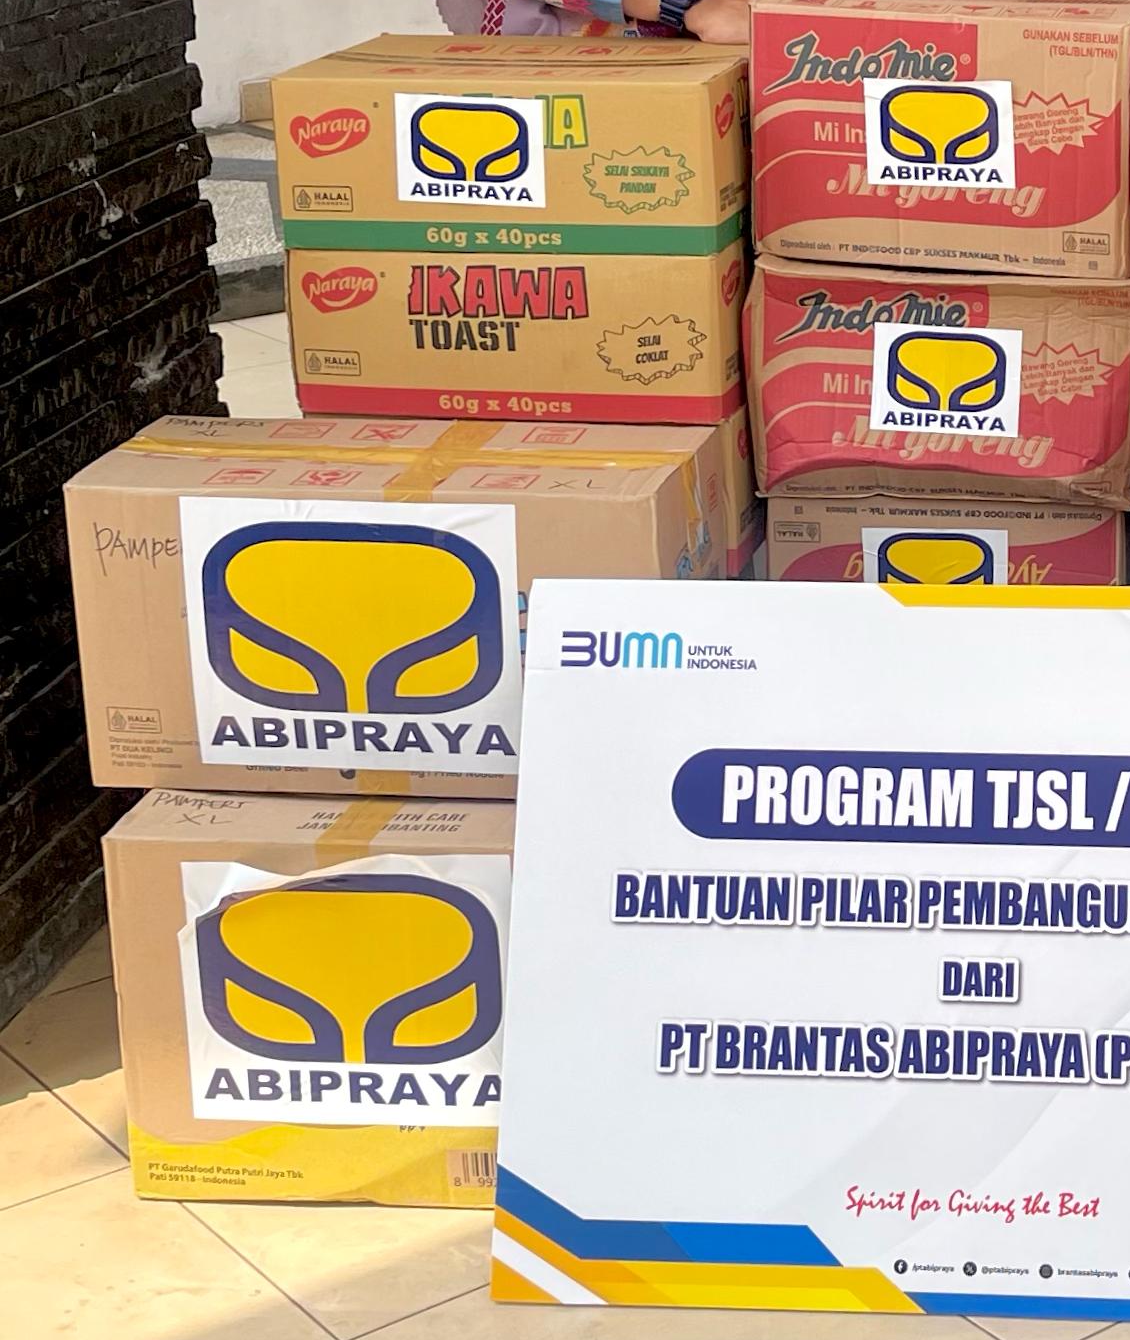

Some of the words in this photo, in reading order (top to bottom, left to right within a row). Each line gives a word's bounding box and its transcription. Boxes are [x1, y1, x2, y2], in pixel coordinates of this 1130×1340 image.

[1023, 29, 1069, 42] GUNAKAN
[1072, 32, 1119, 44] SEBELUM
[298, 111, 367, 140] Naraya
[814, 122, 839, 142] Mi
[880, 166, 1003, 183] ABIPRAYA
[314, 192, 349, 201] HALAL
[411, 182, 533, 202] ABIPRAYA
[619, 182, 656, 195] PANDAN
[427, 227, 467, 247] 60g
[476, 232, 488, 244] x
[496, 229, 562, 248] 40pcs
[308, 274, 374, 295] Naraya
[410, 320, 520, 351] TOAST
[638, 335, 661, 348] SELAI
[324, 357, 357, 366] HALAL
[635, 350, 669, 364] COKLAT
[823, 374, 848, 393] Mi
[439, 395, 480, 415] 60g
[487, 401, 499, 411] x
[508, 397, 572, 415] 40pcs
[883, 411, 1006, 431] ABIPRAYA
[560, 631, 683, 668] BUMN
[688, 646, 732, 656] UNTUK
[687, 659, 757, 670] INDONESIA
[212, 715, 517, 756] ABIPRAYA
[721, 765, 974, 829] PROGRAM
[988, 770, 1094, 831] TJSL
[1106, 772, 1130, 833] /
[428, 813, 470, 821] CARE
[613, 873, 791, 922] BANTUAN
[801, 877, 907, 925] PILAR
[942, 960, 1016, 998] DARI
[660, 1024, 710, 1069] PT
[716, 1026, 890, 1073] BRANTAS
[900, 1031, 1084, 1079] ABIPRAYA
[205, 1067, 501, 1107] ABIPRAYA
[149, 1163, 161, 1172] PT
[162, 1165, 214, 1175] Garudafood
[216, 1167, 240, 1176] Putra
[149, 1172, 167, 1182] Pati
[845, 1186, 906, 1217] Spirit
[910, 1189, 941, 1221] for
[948, 1189, 1015, 1224] Giving
[1023, 1192, 1051, 1215] the
[1058, 1192, 1100, 1218] Best
